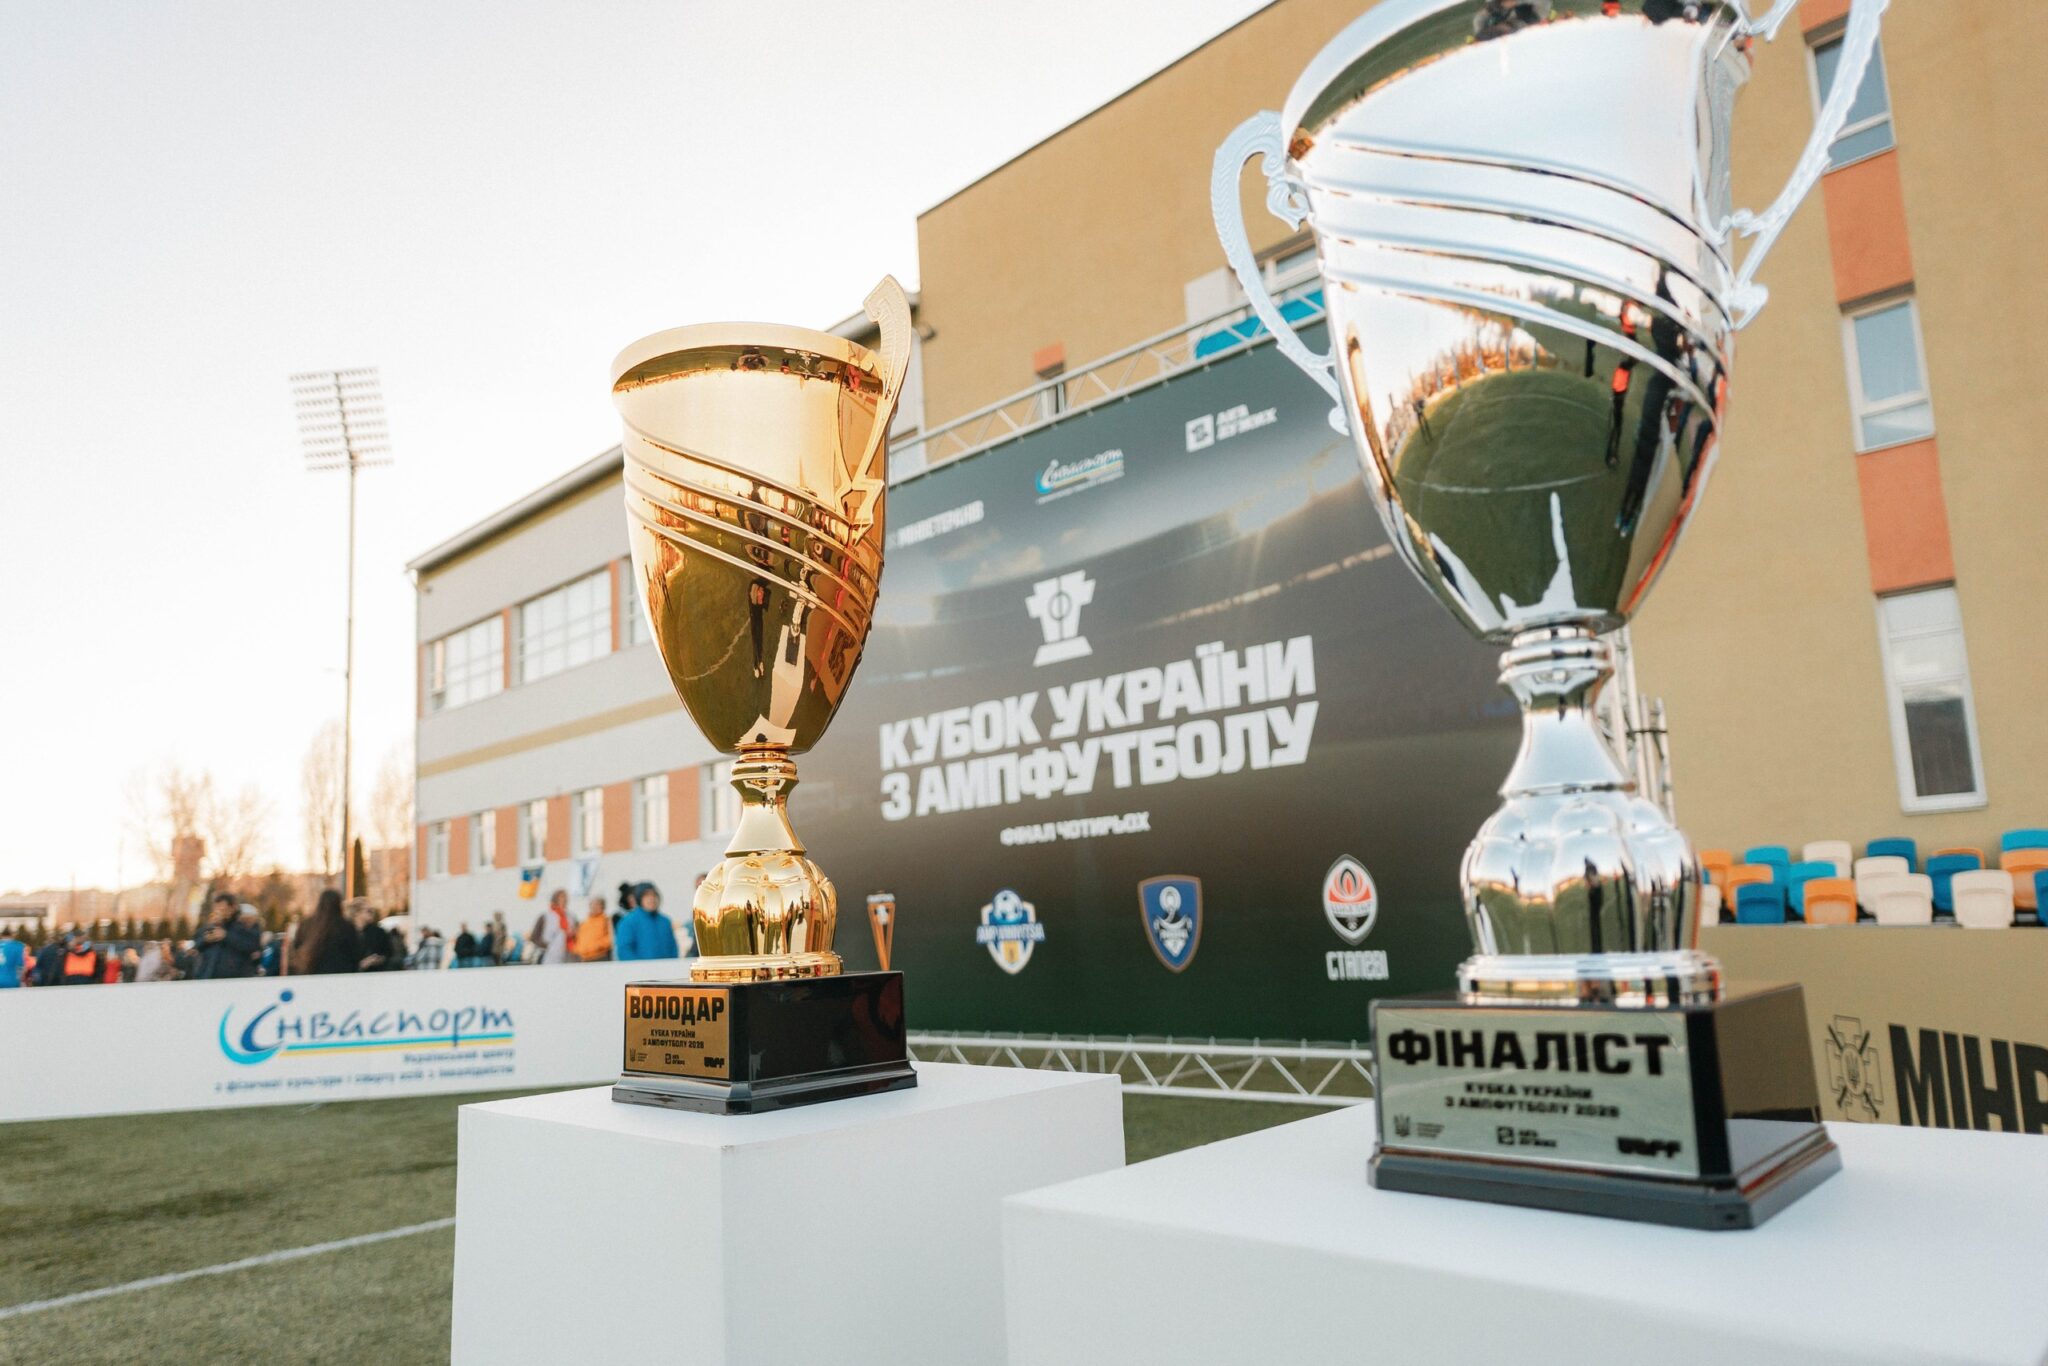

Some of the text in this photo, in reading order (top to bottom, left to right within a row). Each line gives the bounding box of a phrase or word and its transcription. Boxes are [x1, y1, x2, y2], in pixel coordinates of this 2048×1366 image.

[879, 635, 1317, 771] КУБОК УКРАЇНИ
[881, 701, 1319, 822] З АМПФУТБОЛУ
[1000, 811, 1151, 846] ФІНАЛ ЧОТИРЬОХ
[630, 995, 725, 1026] ВОЛОДАР
[650, 1029, 696, 1038] КУБКА УКРАЇНИ
[1388, 1028, 1671, 1077] ФІНАЛІСТ
[1459, 1096, 1570, 1115] АМПФУТБОЛУ
[1465, 1081, 1593, 1099] КУБКА УКРАЇНИ
